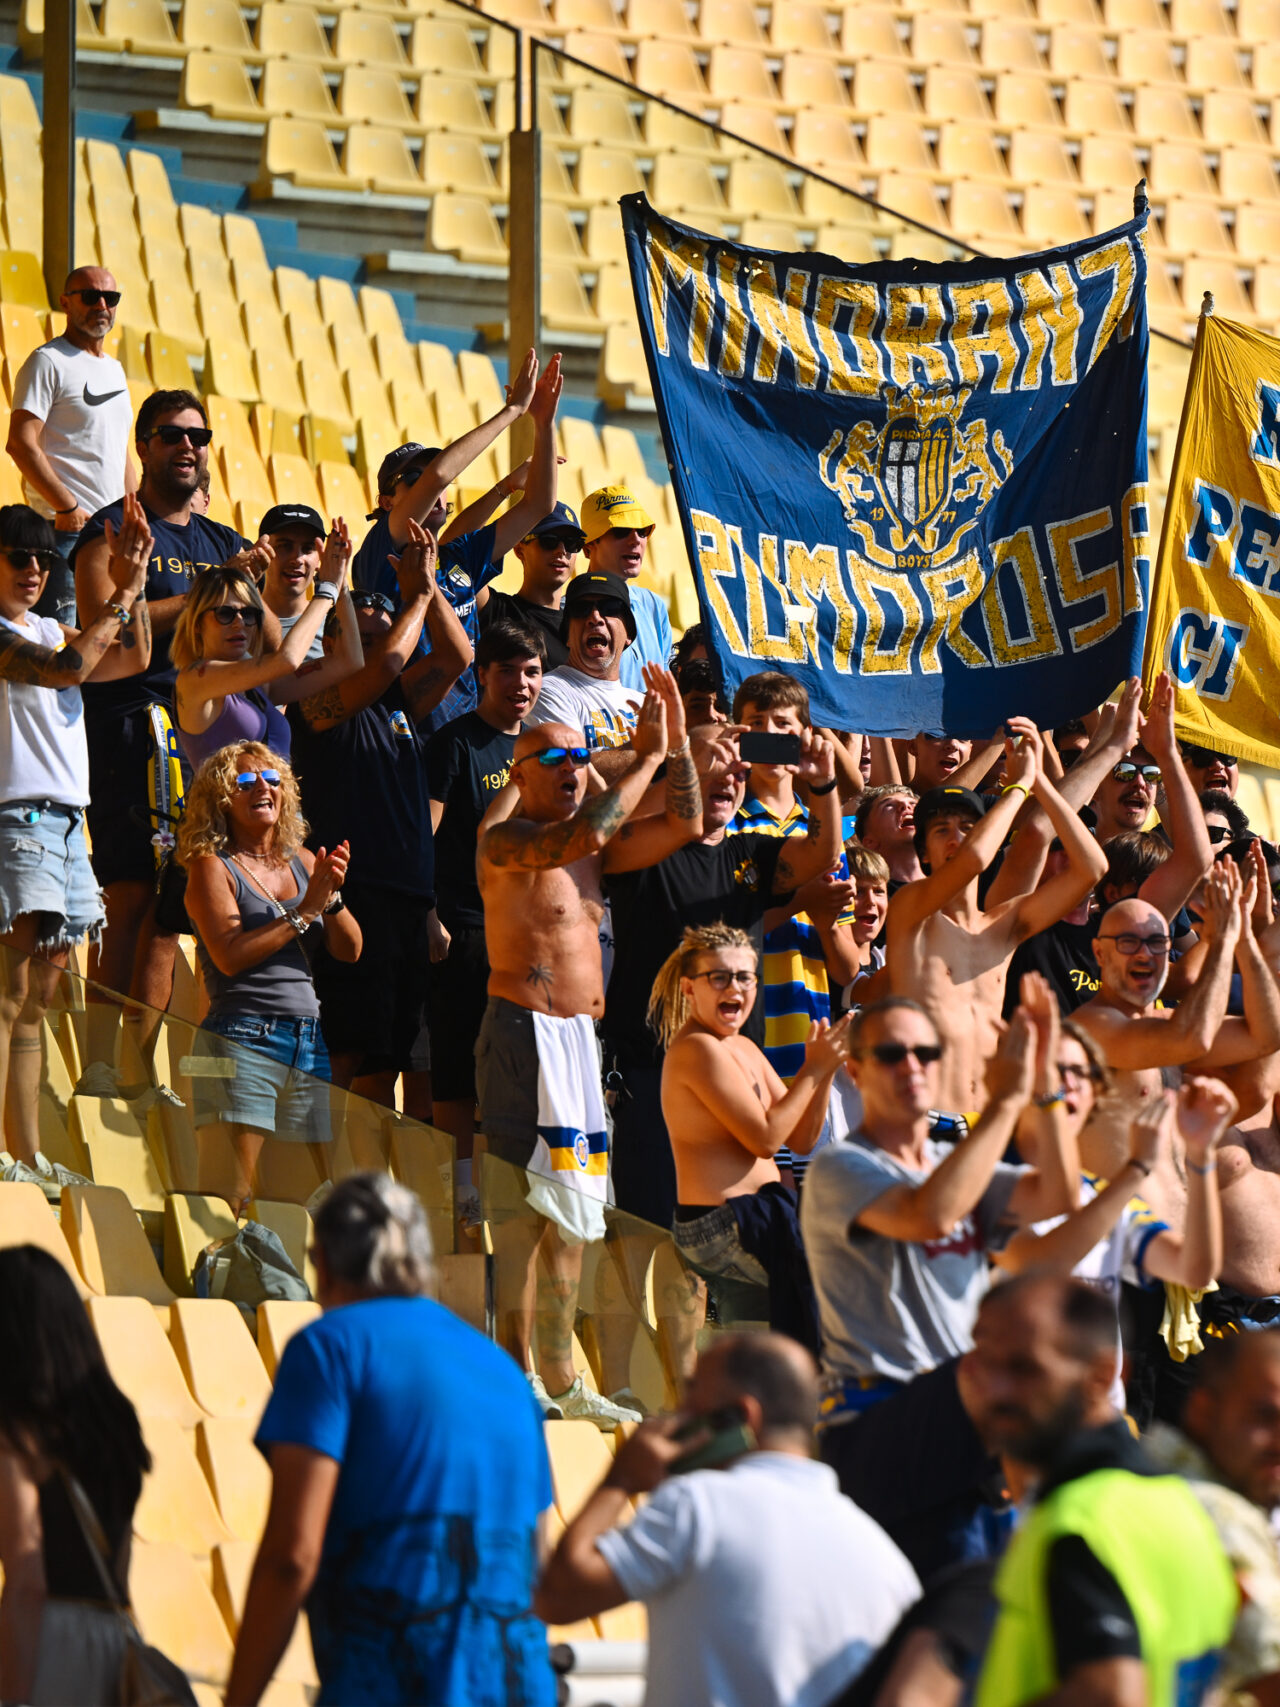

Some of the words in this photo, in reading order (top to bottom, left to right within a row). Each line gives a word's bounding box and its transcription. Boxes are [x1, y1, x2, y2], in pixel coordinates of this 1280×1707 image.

[891, 430, 932, 440] PARMA
[870, 507, 885, 521] 19
[897, 554, 932, 568] BOYS
[1165, 608, 1249, 701] CI
